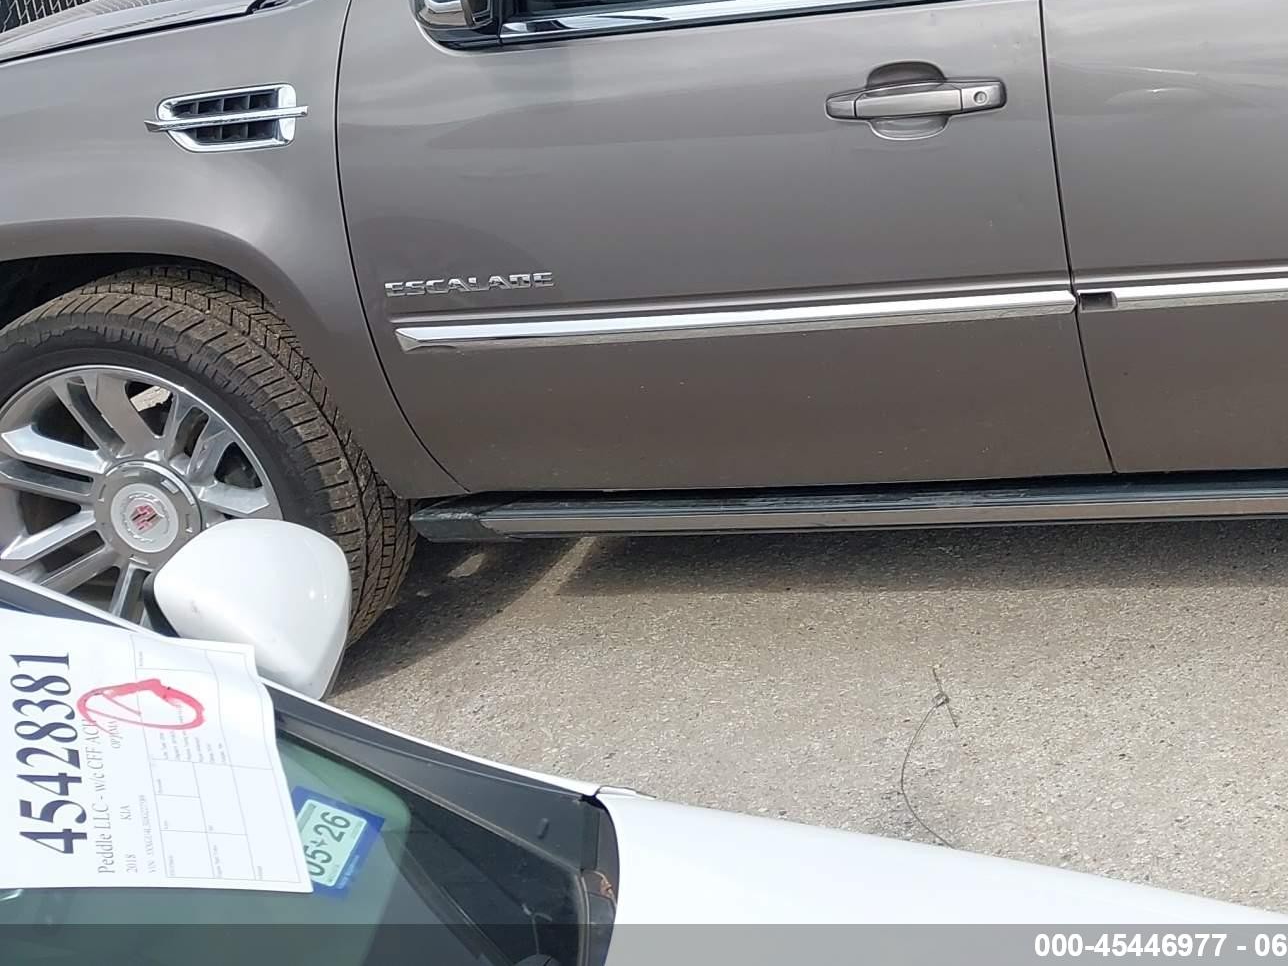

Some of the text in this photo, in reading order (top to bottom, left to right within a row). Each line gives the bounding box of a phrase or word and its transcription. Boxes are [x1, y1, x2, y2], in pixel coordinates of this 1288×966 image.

[384, 272, 554, 297] ESCALADE
[9, 652, 88, 854] 45428381
[92, 803, 111, 830] LLC
[120, 804, 133, 821] KIA
[313, 812, 351, 842] 26
[95, 834, 115, 874] Peddle
[125, 853, 139, 874] 2018
[304, 845, 332, 876] 05
